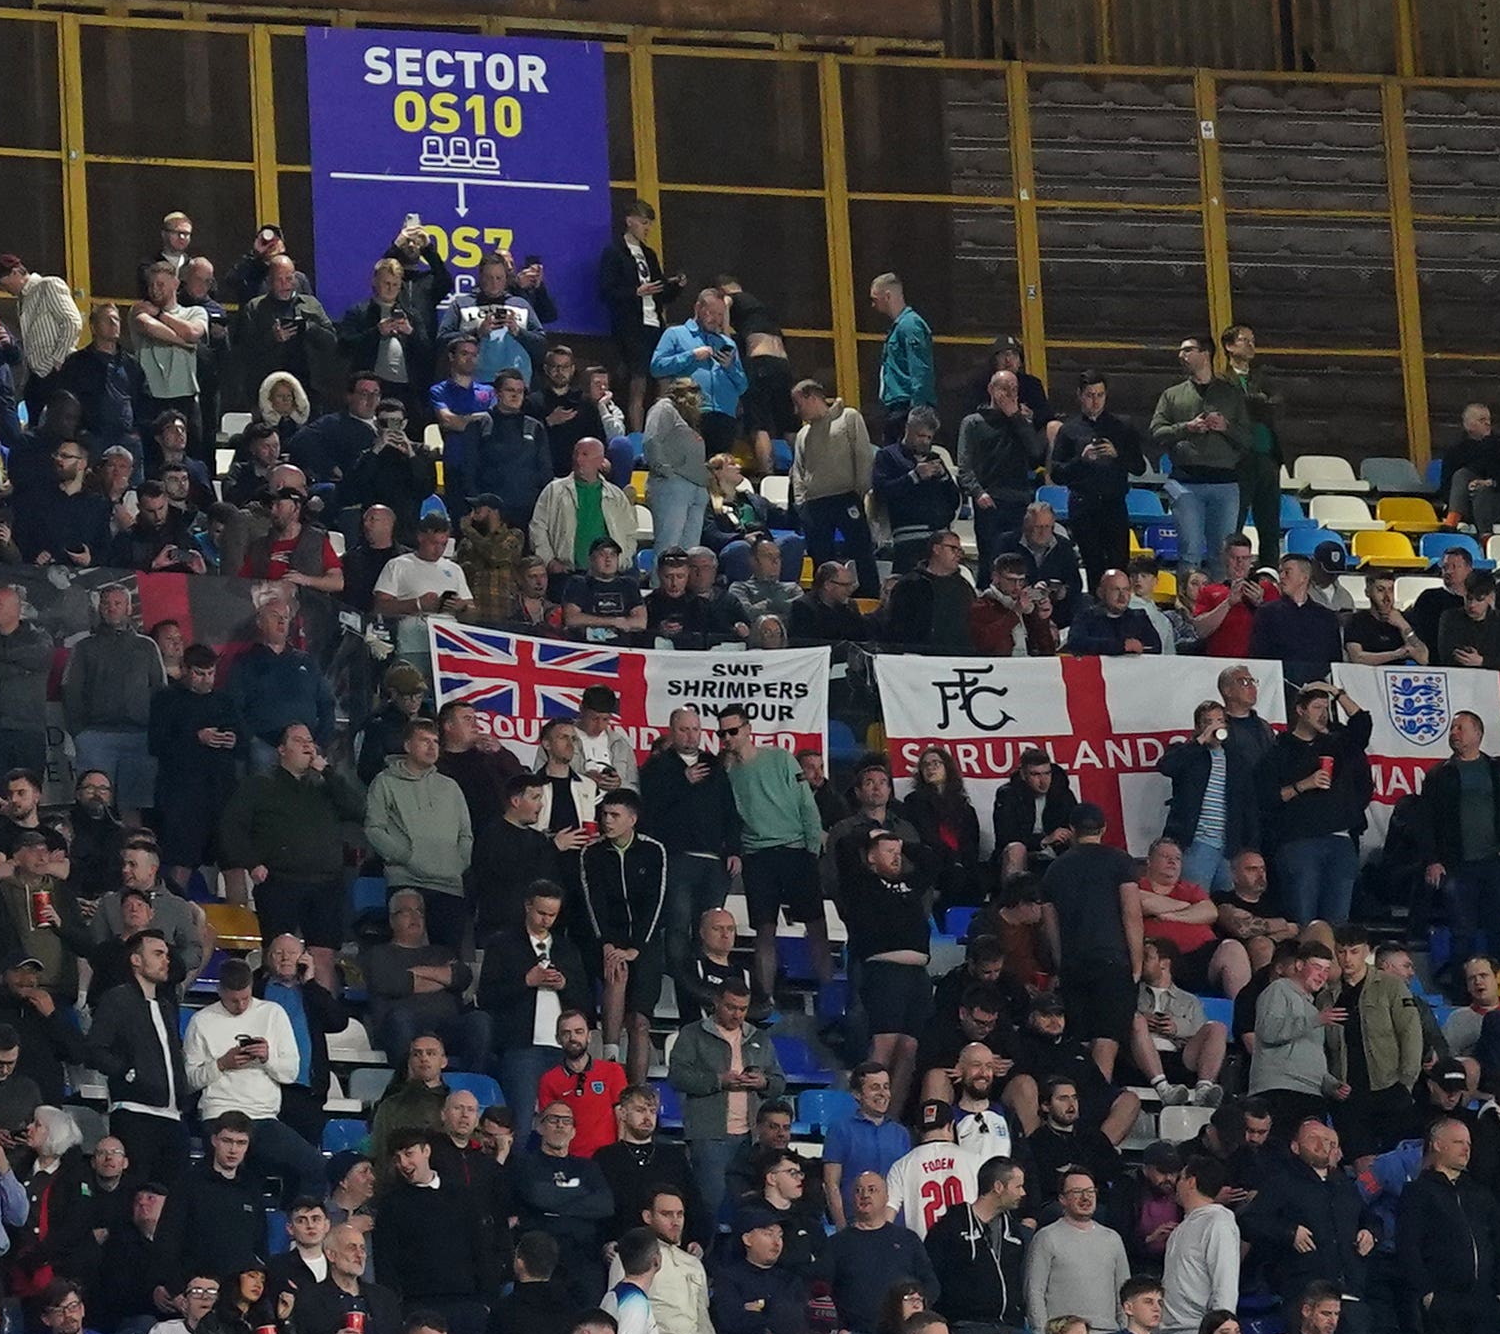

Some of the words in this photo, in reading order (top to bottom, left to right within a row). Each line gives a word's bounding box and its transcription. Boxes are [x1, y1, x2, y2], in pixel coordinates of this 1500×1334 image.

[364, 46, 549, 94] SECTOR
[393, 90, 523, 139] OS10
[667, 679, 809, 699] SHRIMPERS
[921, 1157, 955, 1174] FODEN
[920, 1175, 964, 1231] 20
